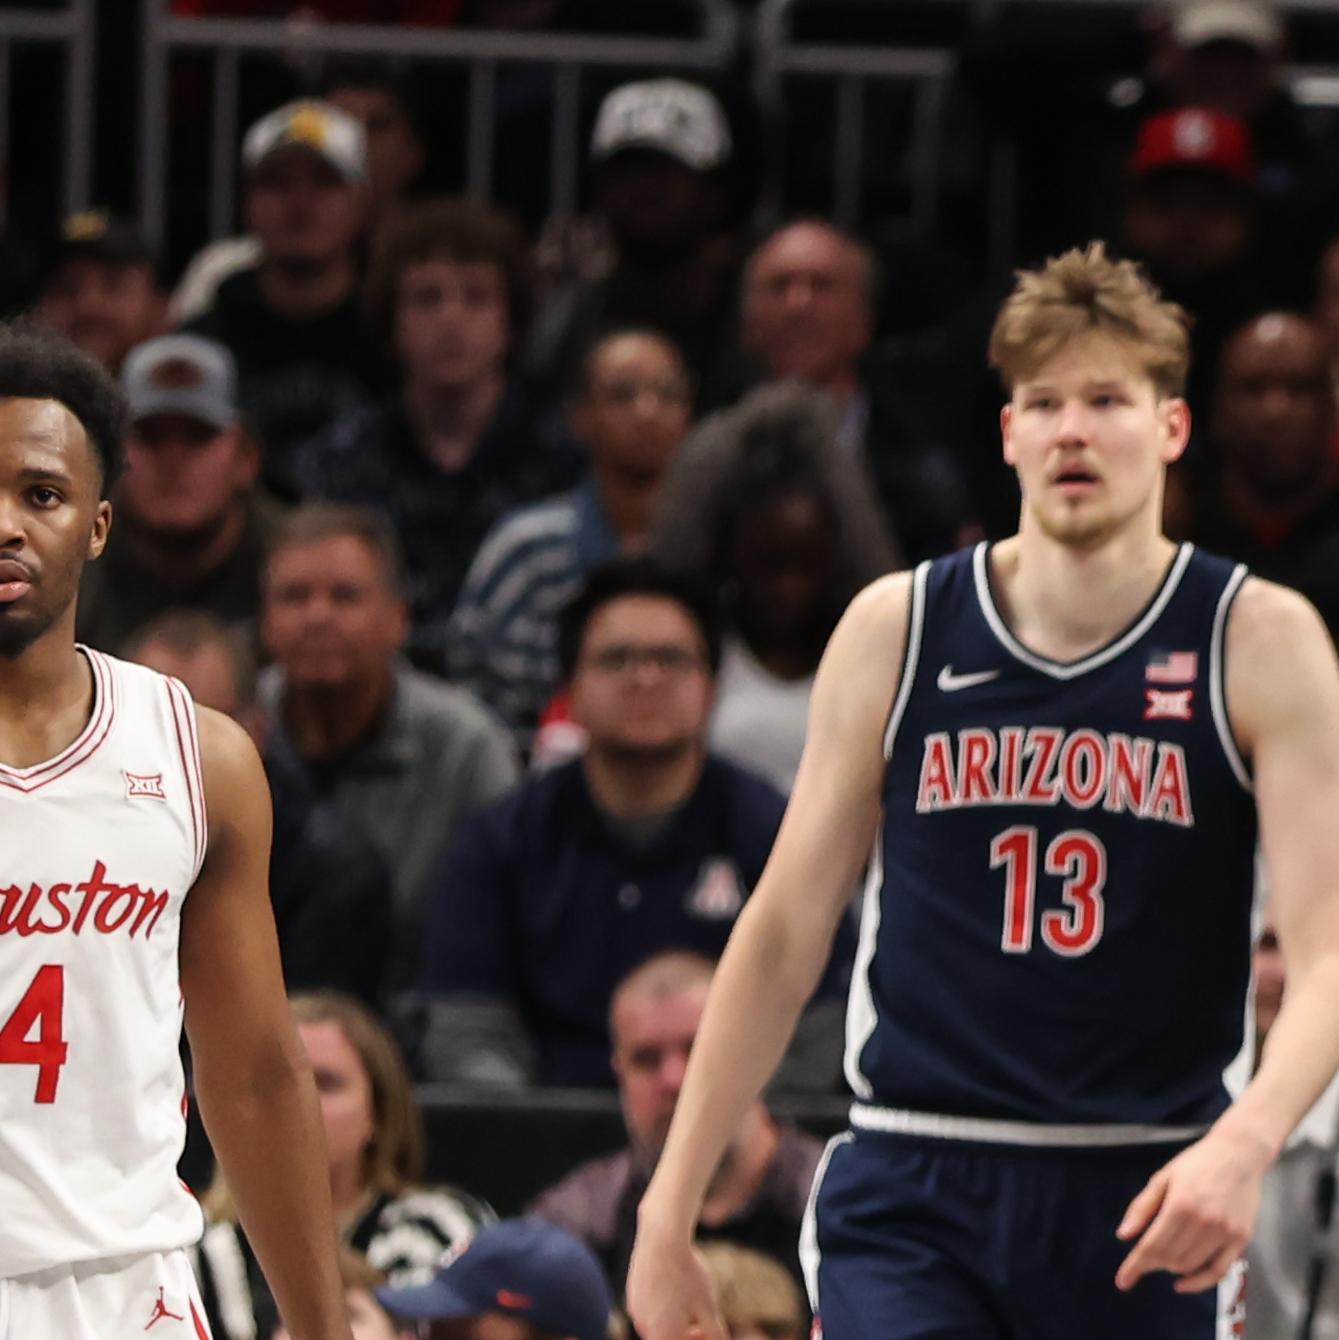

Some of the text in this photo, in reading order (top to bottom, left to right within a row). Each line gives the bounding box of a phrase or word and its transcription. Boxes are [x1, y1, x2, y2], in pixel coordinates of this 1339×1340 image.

[916, 727, 1194, 828] ARIZONA
[0, 858, 169, 942] uston
[989, 825, 1108, 957] 13
[0, 965, 68, 1105] 4
